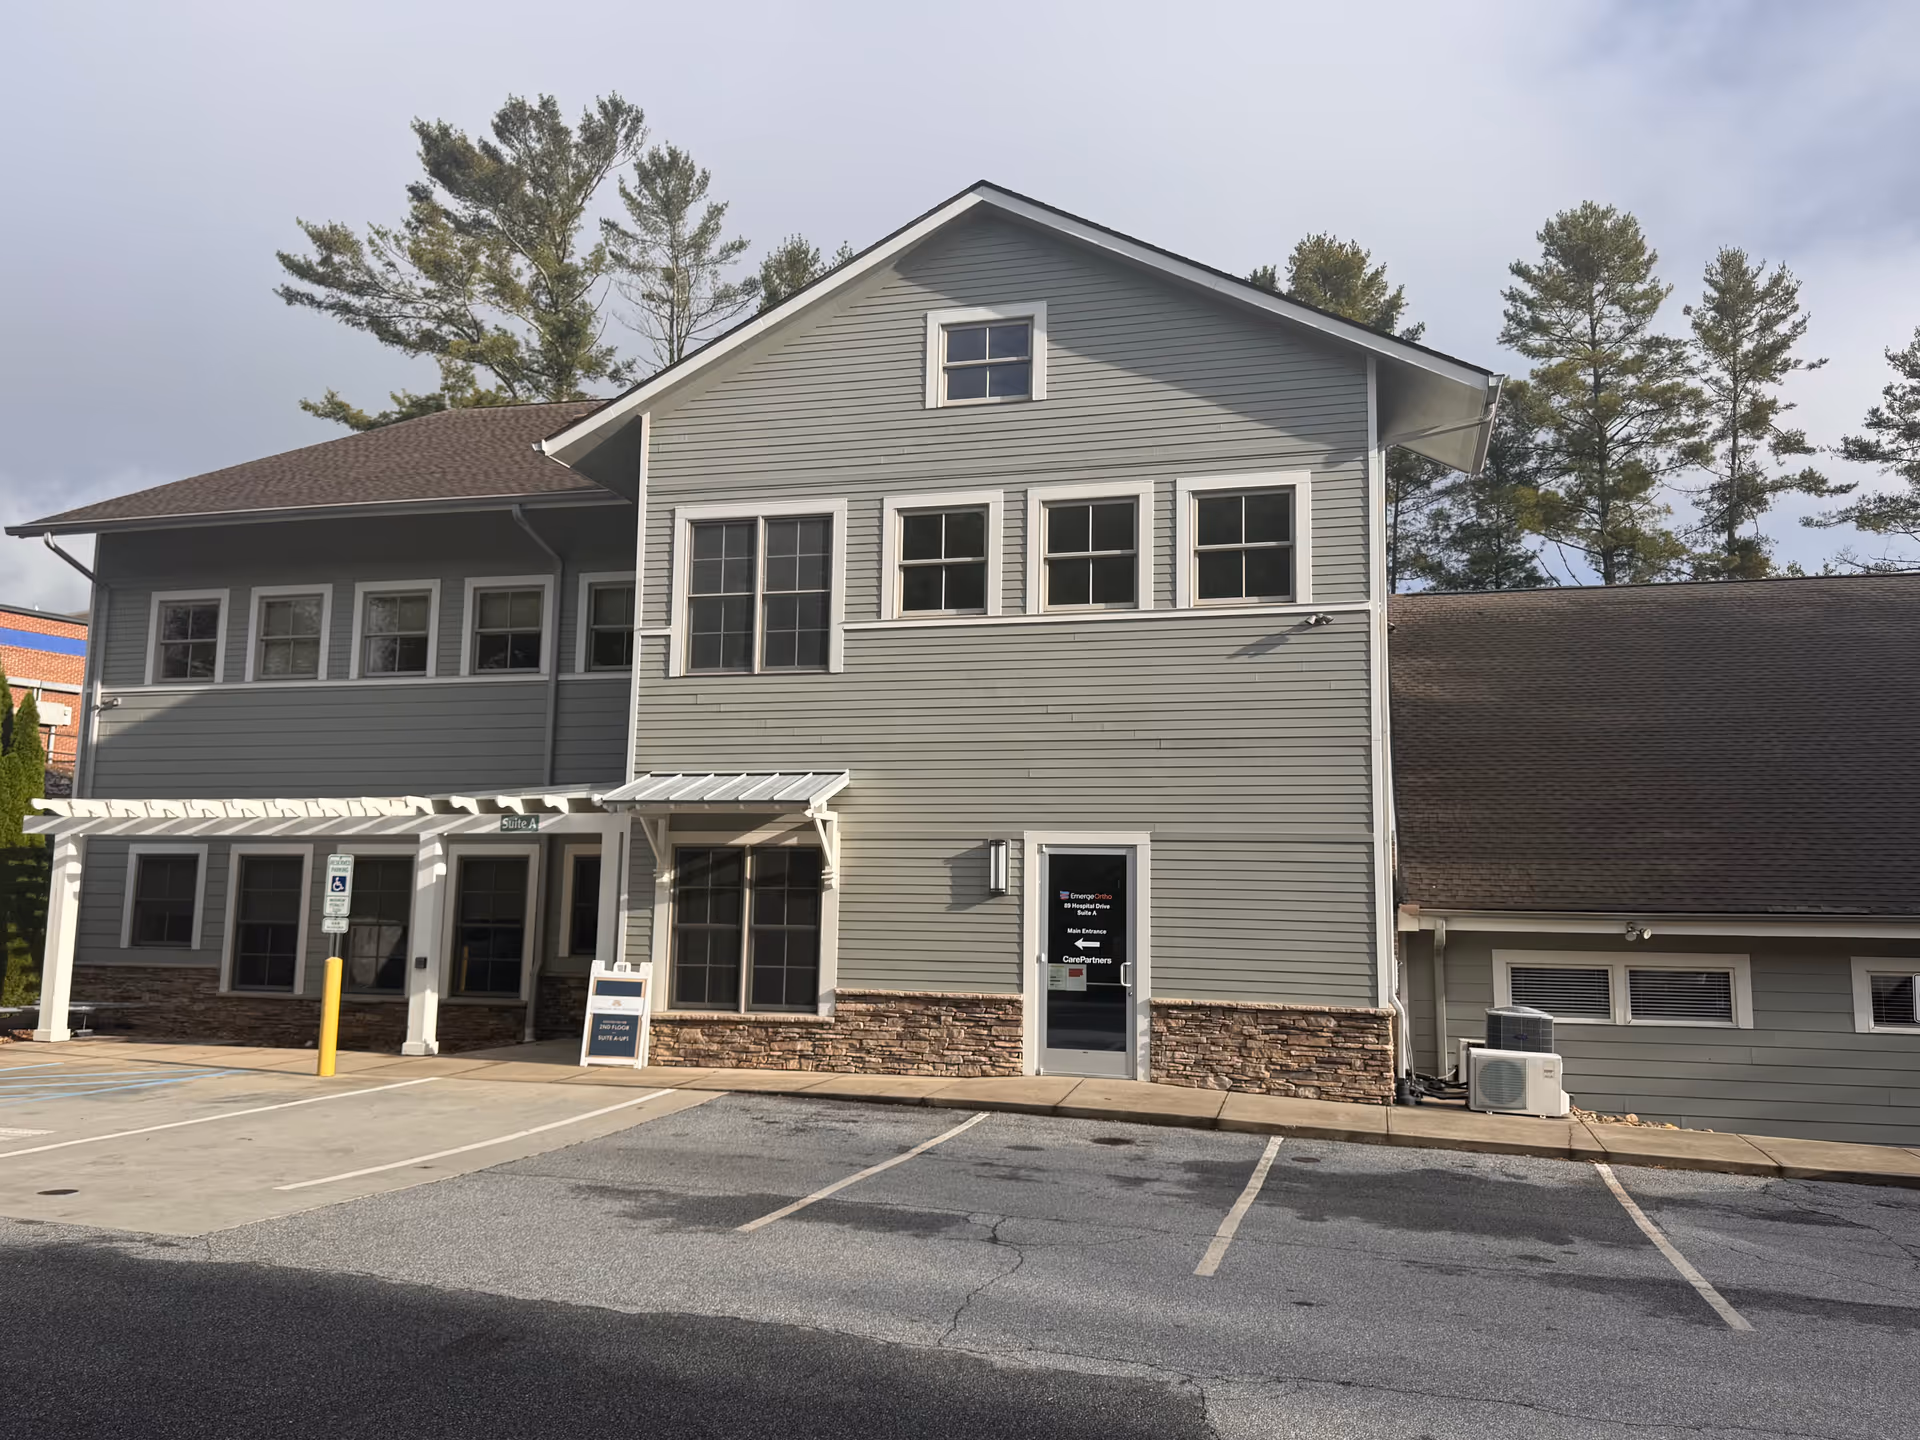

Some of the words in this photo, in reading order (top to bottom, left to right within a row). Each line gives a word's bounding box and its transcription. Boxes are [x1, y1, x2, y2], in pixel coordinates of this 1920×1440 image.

[502, 817, 527, 829] Suite
[528, 817, 537, 829] A
[1062, 956, 1112, 964] CarePartners
